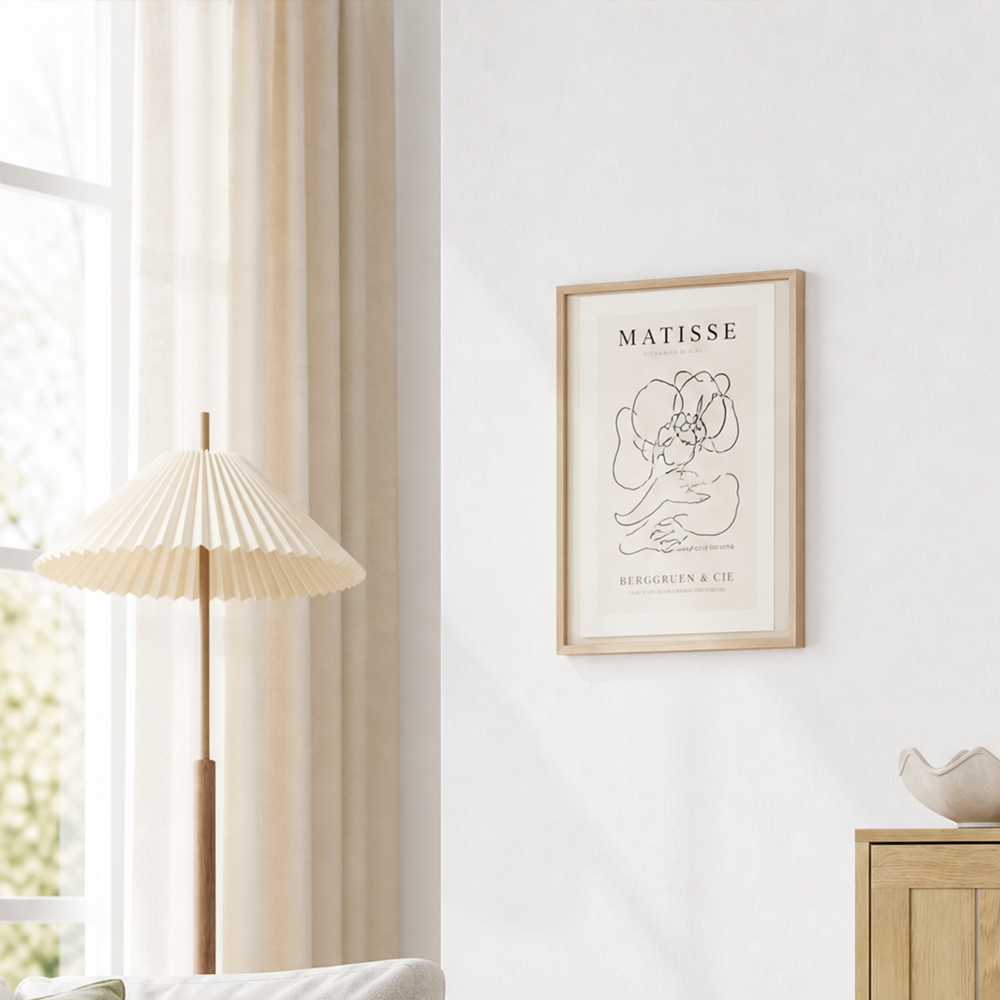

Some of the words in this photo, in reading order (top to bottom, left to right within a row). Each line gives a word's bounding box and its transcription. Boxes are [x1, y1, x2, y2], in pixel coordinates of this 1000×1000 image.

[618, 322, 737, 347] MATISSE
[619, 573, 695, 586] BERGGRUEN
[699, 573, 708, 583] &
[713, 571, 734, 582] CIE
